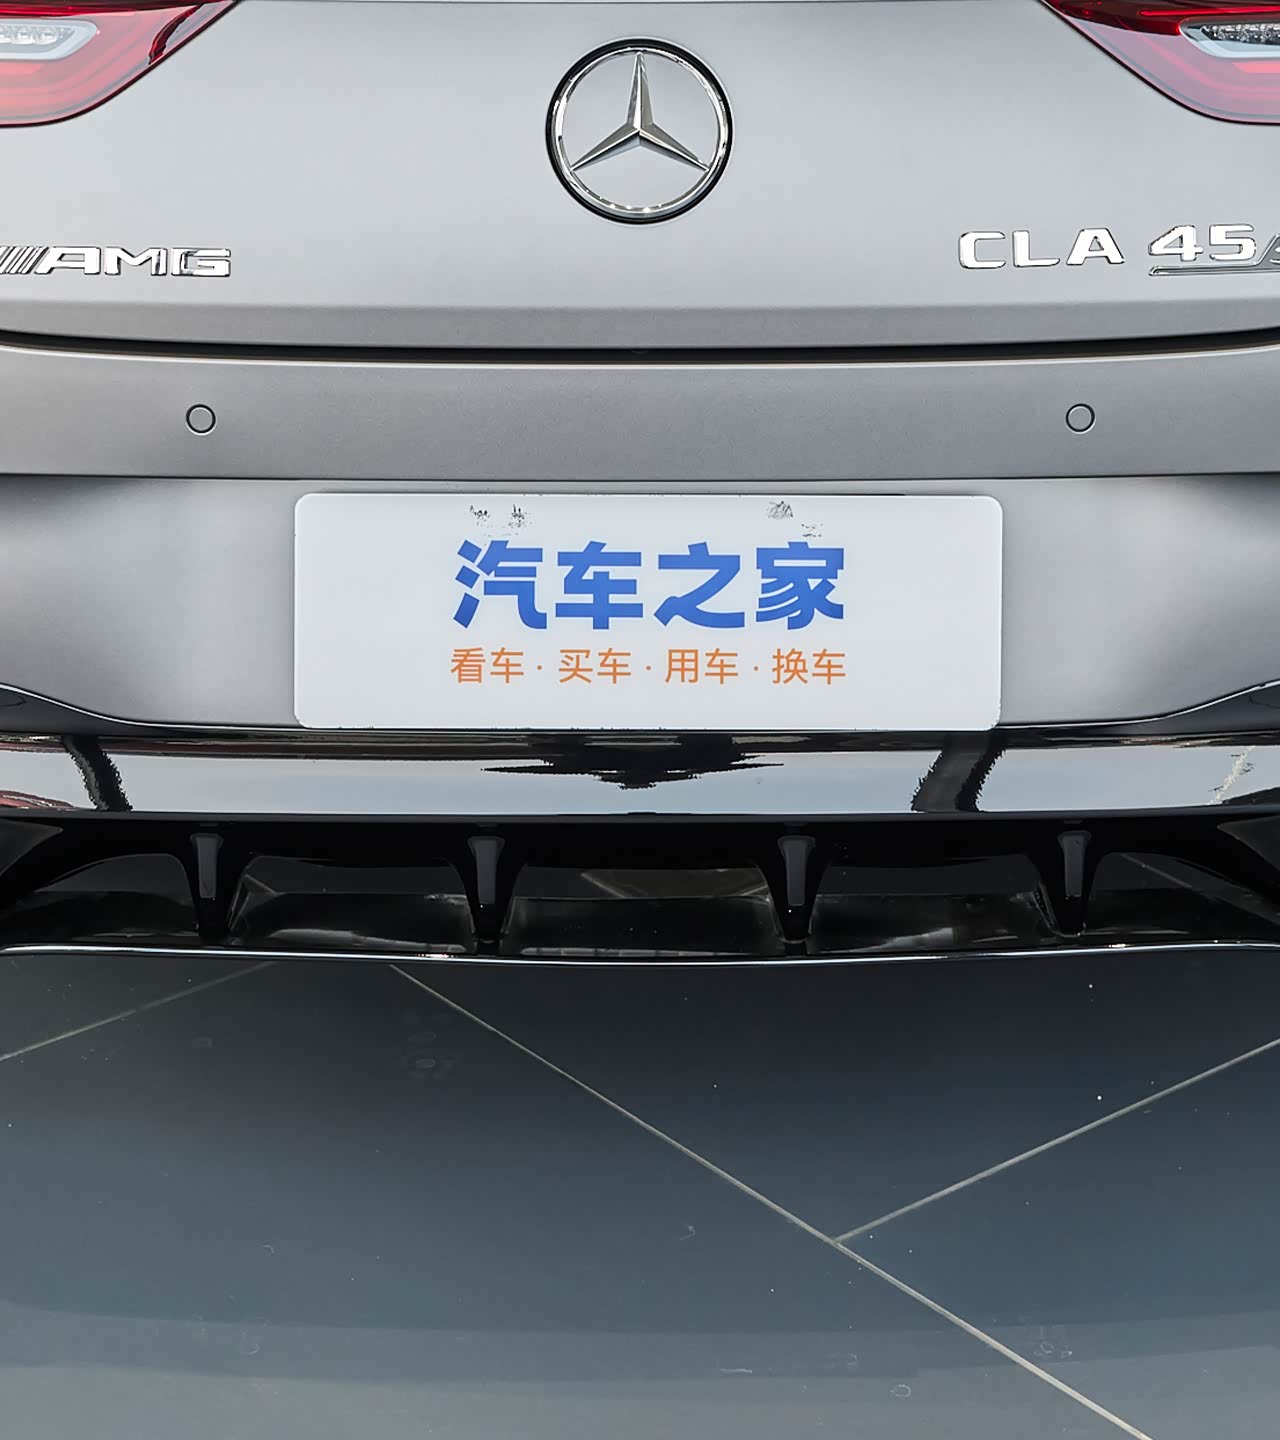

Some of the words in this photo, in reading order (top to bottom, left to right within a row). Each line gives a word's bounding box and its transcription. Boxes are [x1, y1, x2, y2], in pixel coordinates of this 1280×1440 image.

[34, 247, 231, 277] AMG
[958, 227, 1125, 270] CLA
[453, 540, 844, 630] 汽车之家
